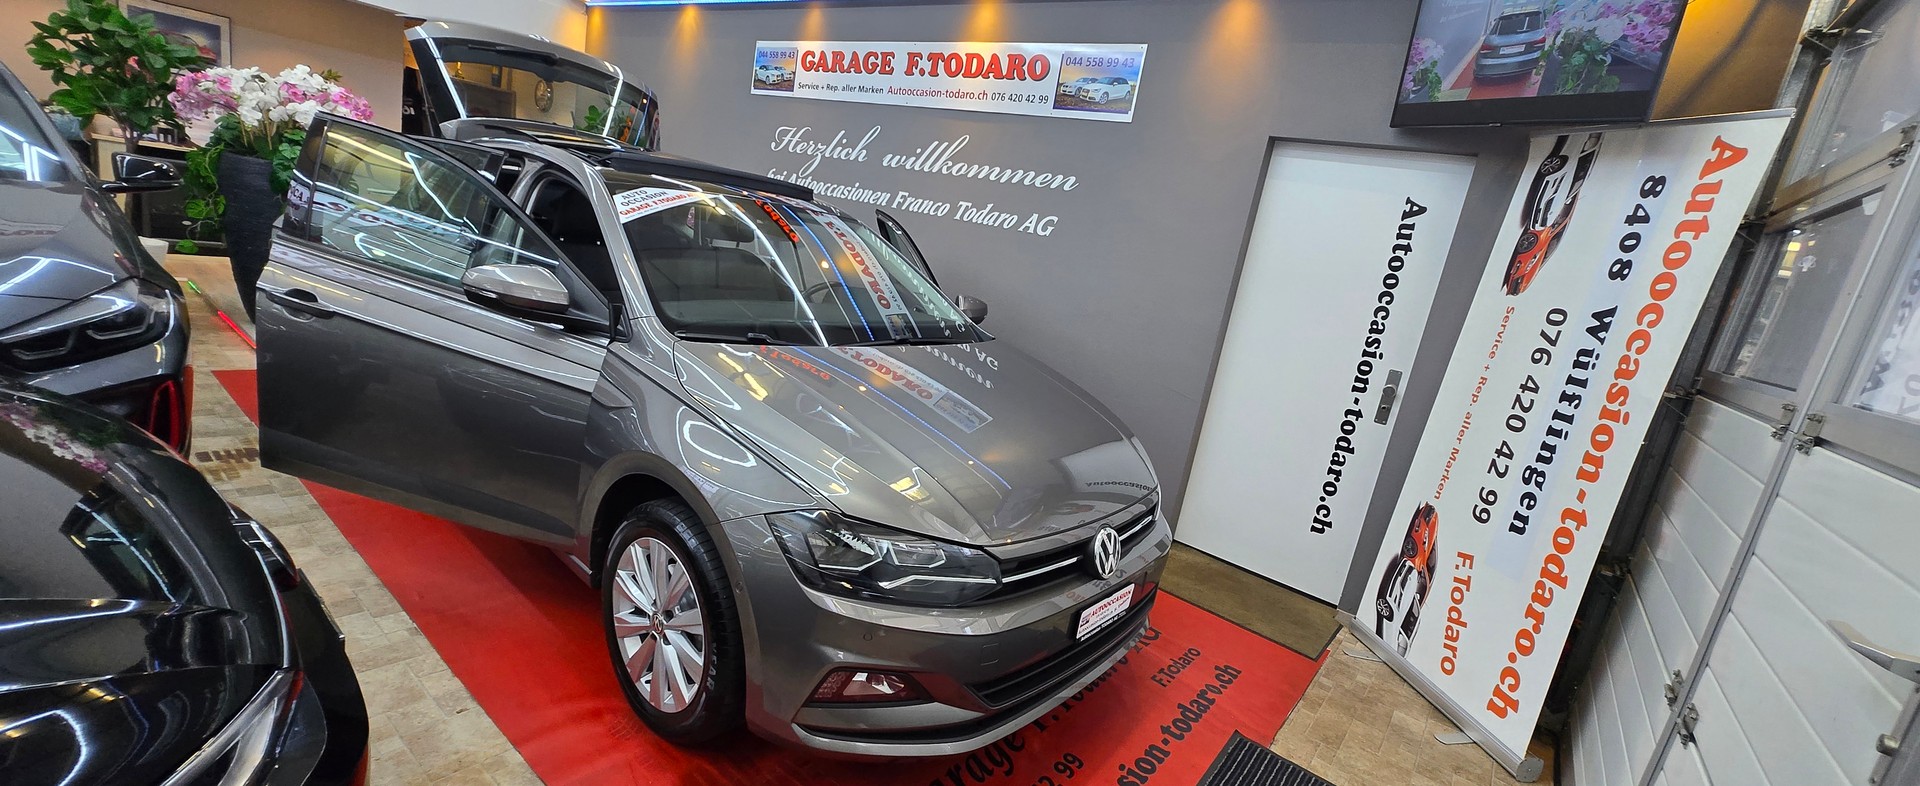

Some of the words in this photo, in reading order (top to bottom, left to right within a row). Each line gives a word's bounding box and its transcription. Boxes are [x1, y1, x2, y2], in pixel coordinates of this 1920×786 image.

[758, 51, 769, 59] 044
[769, 51, 779, 59] 558
[779, 51, 787, 59] 99
[787, 51, 795, 59] 43
[800, 50, 896, 76] GARAGE
[904, 51, 1051, 82] F.TODARO
[1065, 56, 1083, 67] 044
[1085, 56, 1104, 68] 558
[1106, 57, 1120, 68] 99
[1122, 57, 1135, 68] 43
[798, 82, 820, 91] Service
[826, 83, 840, 94] Rep.
[841, 84, 857, 93] aller
[857, 85, 884, 95] Marken
[886, 85, 988, 101] Autooccasion-todaro.ch
[991, 93, 1006, 102] 076
[1007, 94, 1023, 103] 420
[1024, 94, 1037, 104] 42
[1038, 95, 1049, 105] 99
[770, 125, 881, 178] Herzlich
[882, 134, 1079, 191] willkommen
[619, 202, 653, 216] GARAGE
[620, 191, 668, 207] OCCASION
[621, 190, 648, 200] AUTO
[788, 173, 891, 206] Autooccasionen
[891, 190, 951, 217] Franco
[953, 201, 1018, 229] Todaro
[1017, 212, 1059, 237] AG
[1607, 174, 1667, 282] 8408
[1488, 305, 1516, 360] Service
[1530, 307, 1569, 367] 076
[1310, 196, 1428, 536] Autooccasion-todaro.ch
[1469, 375, 1489, 407] Rep.
[1505, 374, 1541, 433] 420
[1456, 411, 1473, 445] aller
[1486, 135, 1748, 720] Autooccasion-todaro.ch
[1508, 304, 1618, 536] Wülflingen
[1433, 447, 1461, 500] Marken
[1487, 440, 1515, 480] 42
[1471, 486, 1499, 525] 99
[1440, 551, 1476, 677] F.Todaro
[1150, 646, 1202, 689] F.Todaro
[1053, 751, 1085, 780] 99
